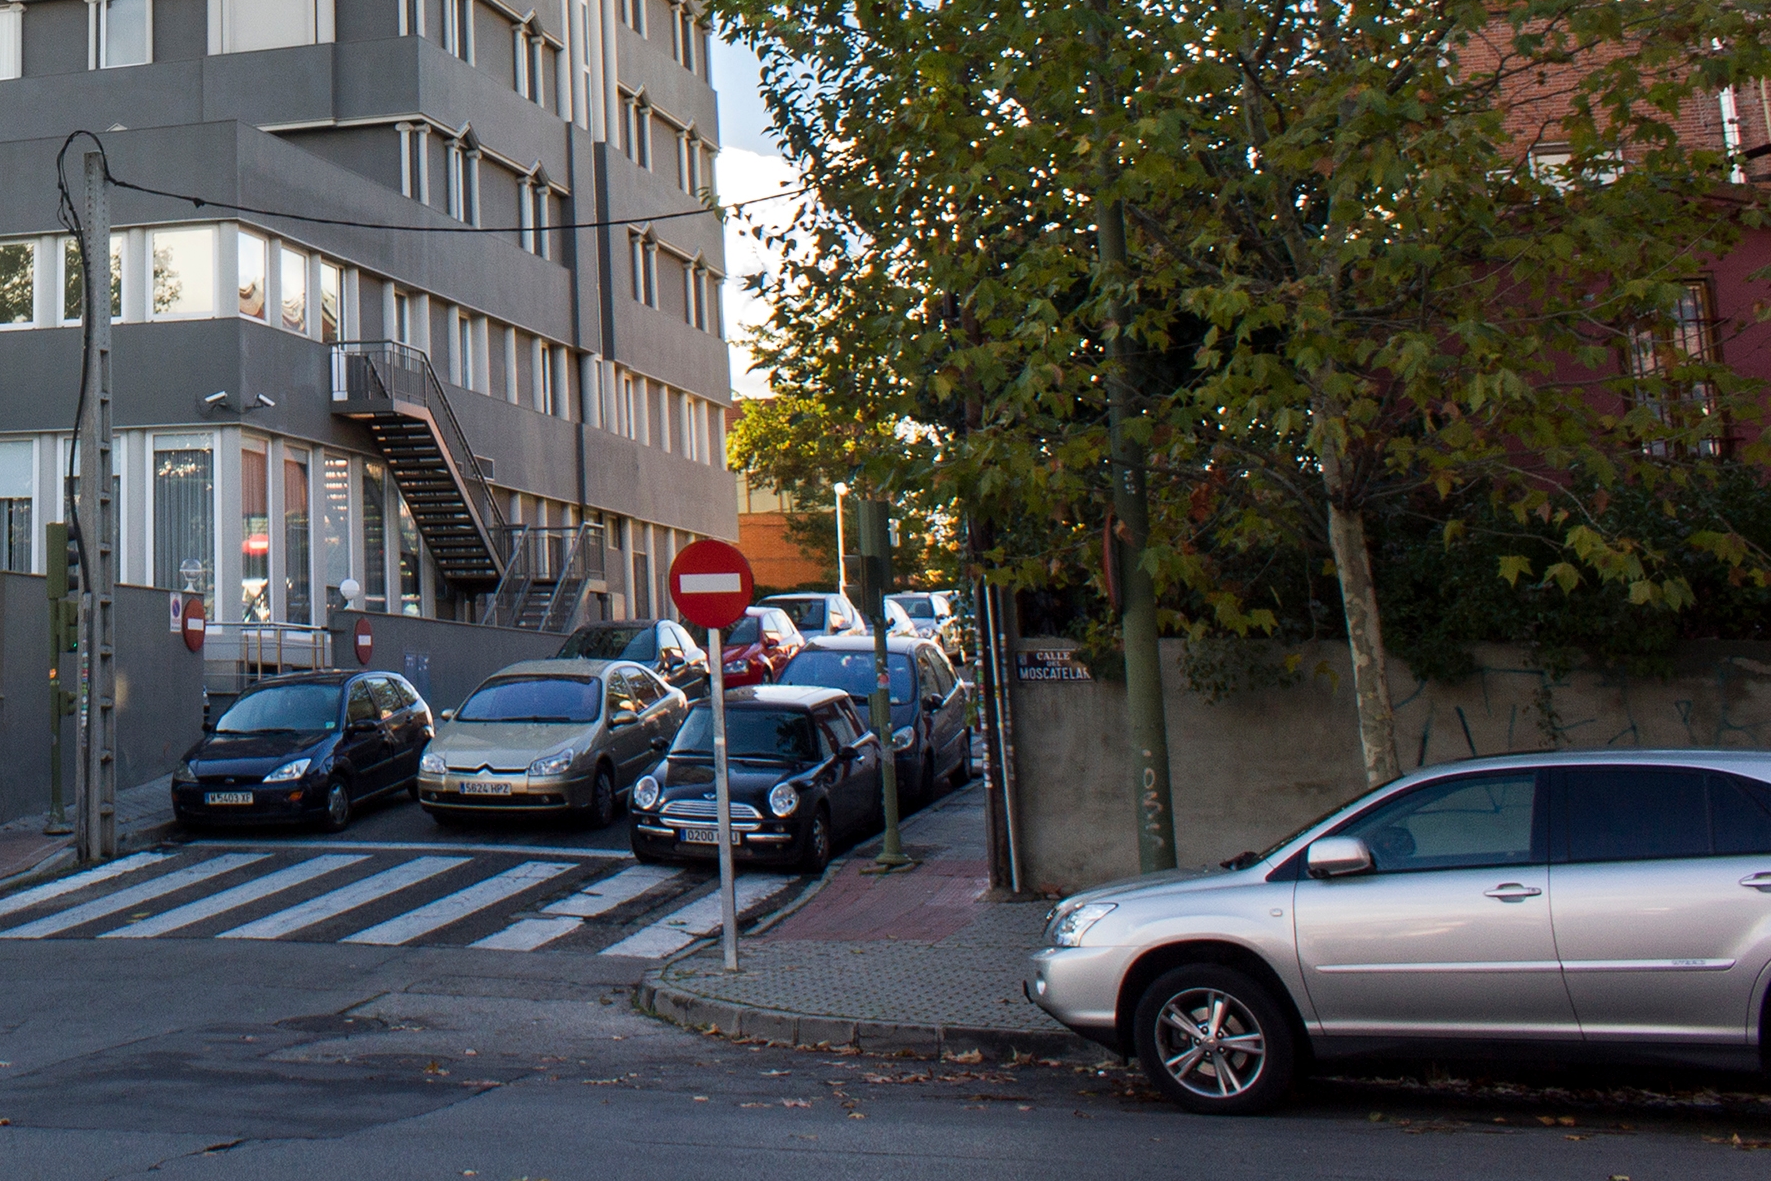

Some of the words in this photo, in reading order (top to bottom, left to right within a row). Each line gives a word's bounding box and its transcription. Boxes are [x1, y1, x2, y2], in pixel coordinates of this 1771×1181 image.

[1036, 651, 1070, 661] CALLE
[465, 782, 488, 793] 5624
[688, 830, 713, 841] 0200
